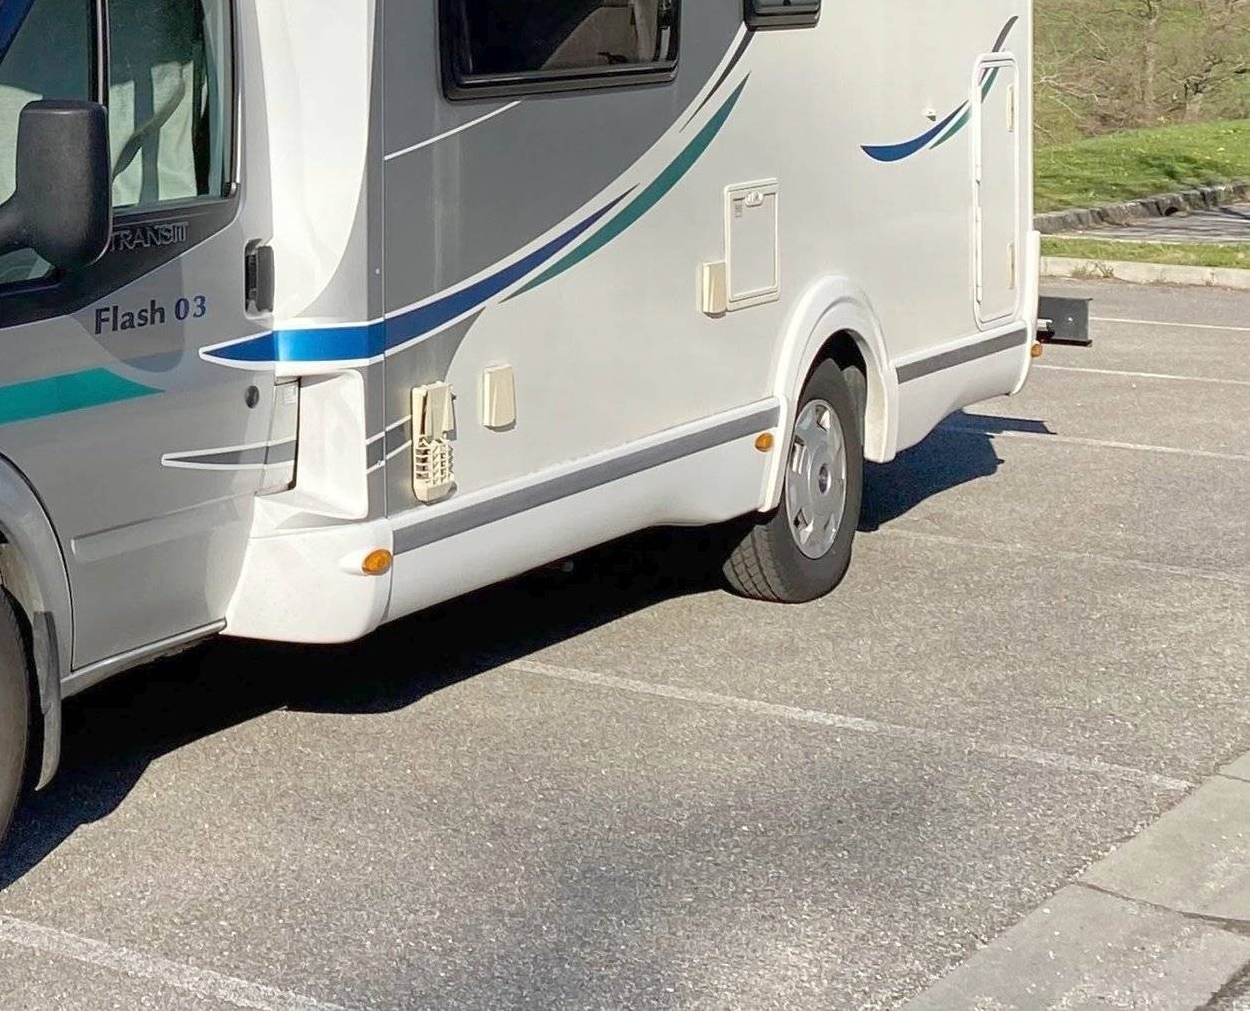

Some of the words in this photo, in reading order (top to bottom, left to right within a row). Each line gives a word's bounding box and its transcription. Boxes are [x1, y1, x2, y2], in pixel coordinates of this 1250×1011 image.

[111, 221, 189, 251] TRANSIT
[94, 299, 166, 335] Flash
[174, 295, 207, 321] 03
